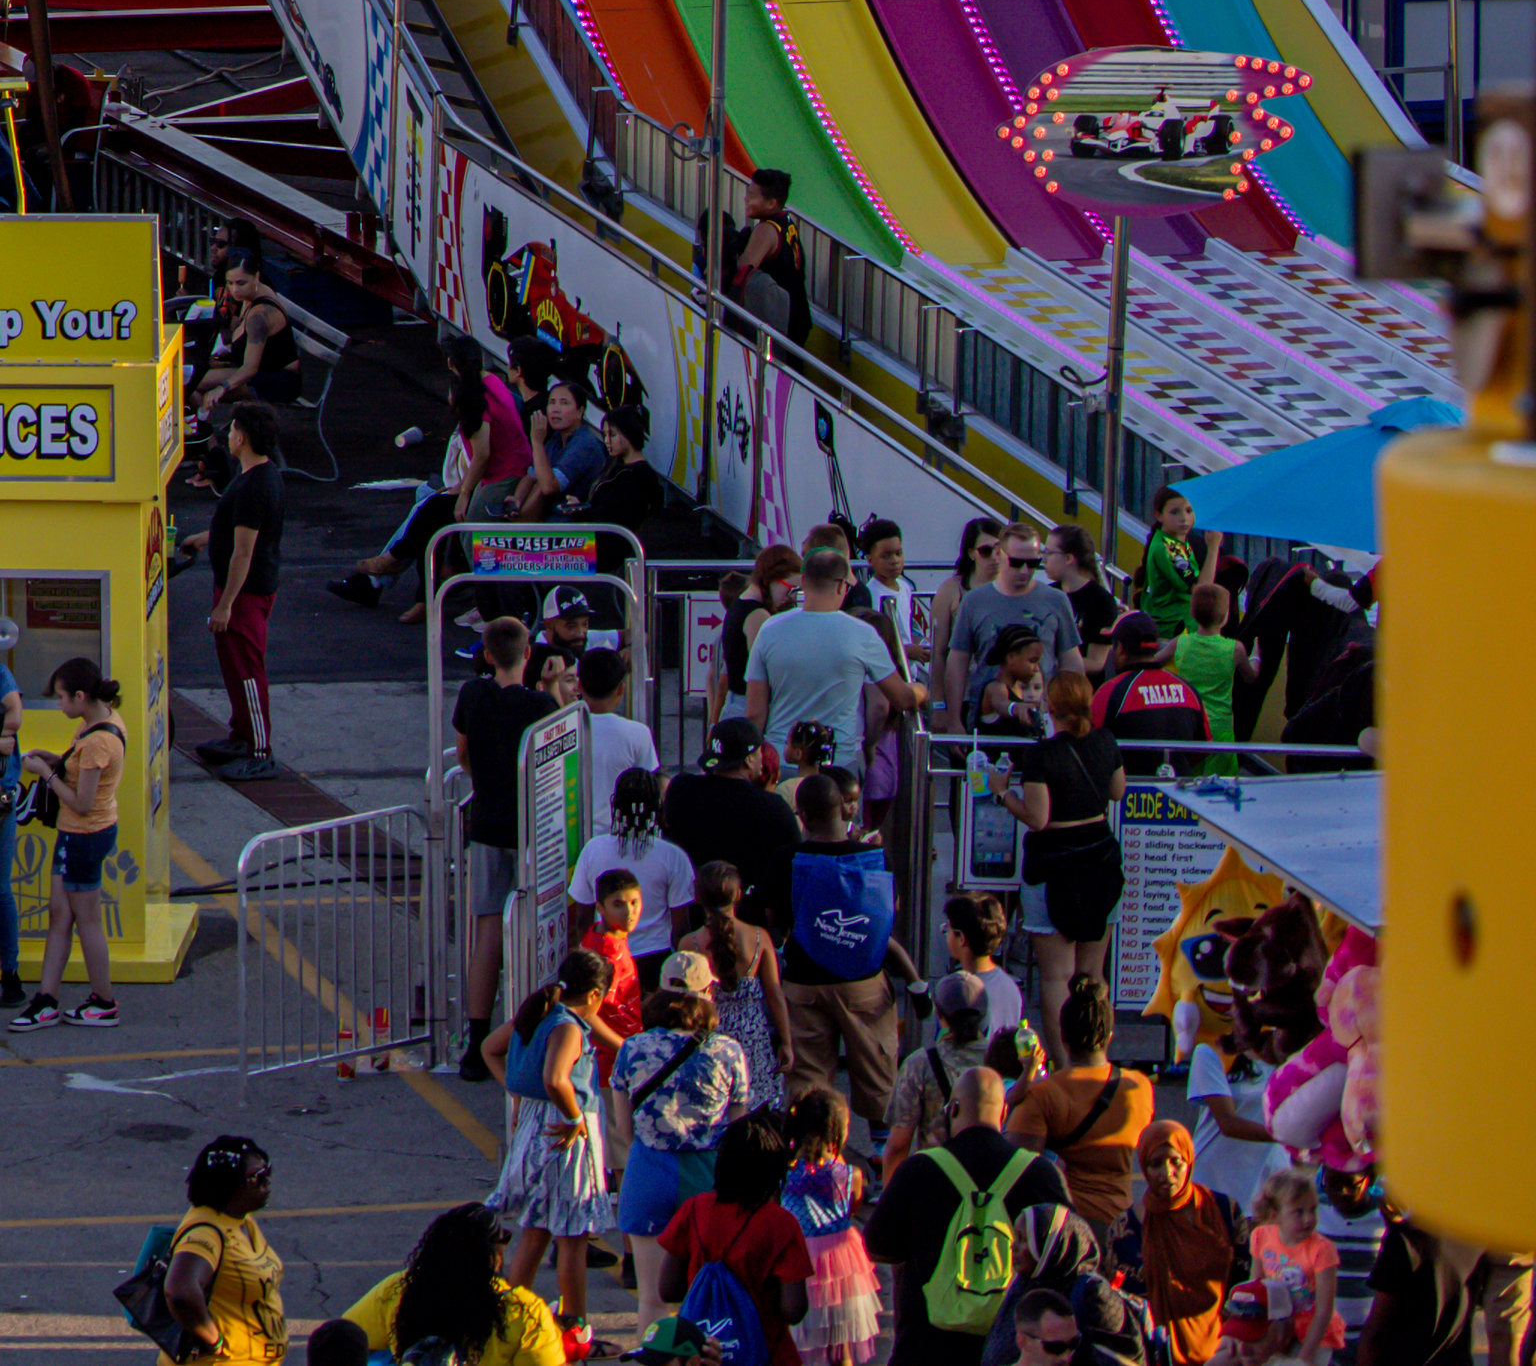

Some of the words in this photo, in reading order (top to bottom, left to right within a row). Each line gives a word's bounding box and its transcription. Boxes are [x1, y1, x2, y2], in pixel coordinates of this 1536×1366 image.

[32, 300, 137, 339] You?
[482, 537, 513, 548] FAST
[517, 539, 548, 551] PASS
[552, 538, 584, 548] LANE
[1138, 684, 1185, 706] TALLEY
[1125, 792, 1163, 819] SLIDE
[1124, 828, 1140, 836] NO
[1145, 828, 1176, 837] double
[1179, 828, 1206, 839] riding
[1124, 853, 1140, 861] NO
[1144, 854, 1168, 862] head
[1171, 853, 1193, 862] first
[1145, 867, 1177, 876] turning
[1123, 890, 1139, 898] NO
[1143, 890, 1171, 900] laying
